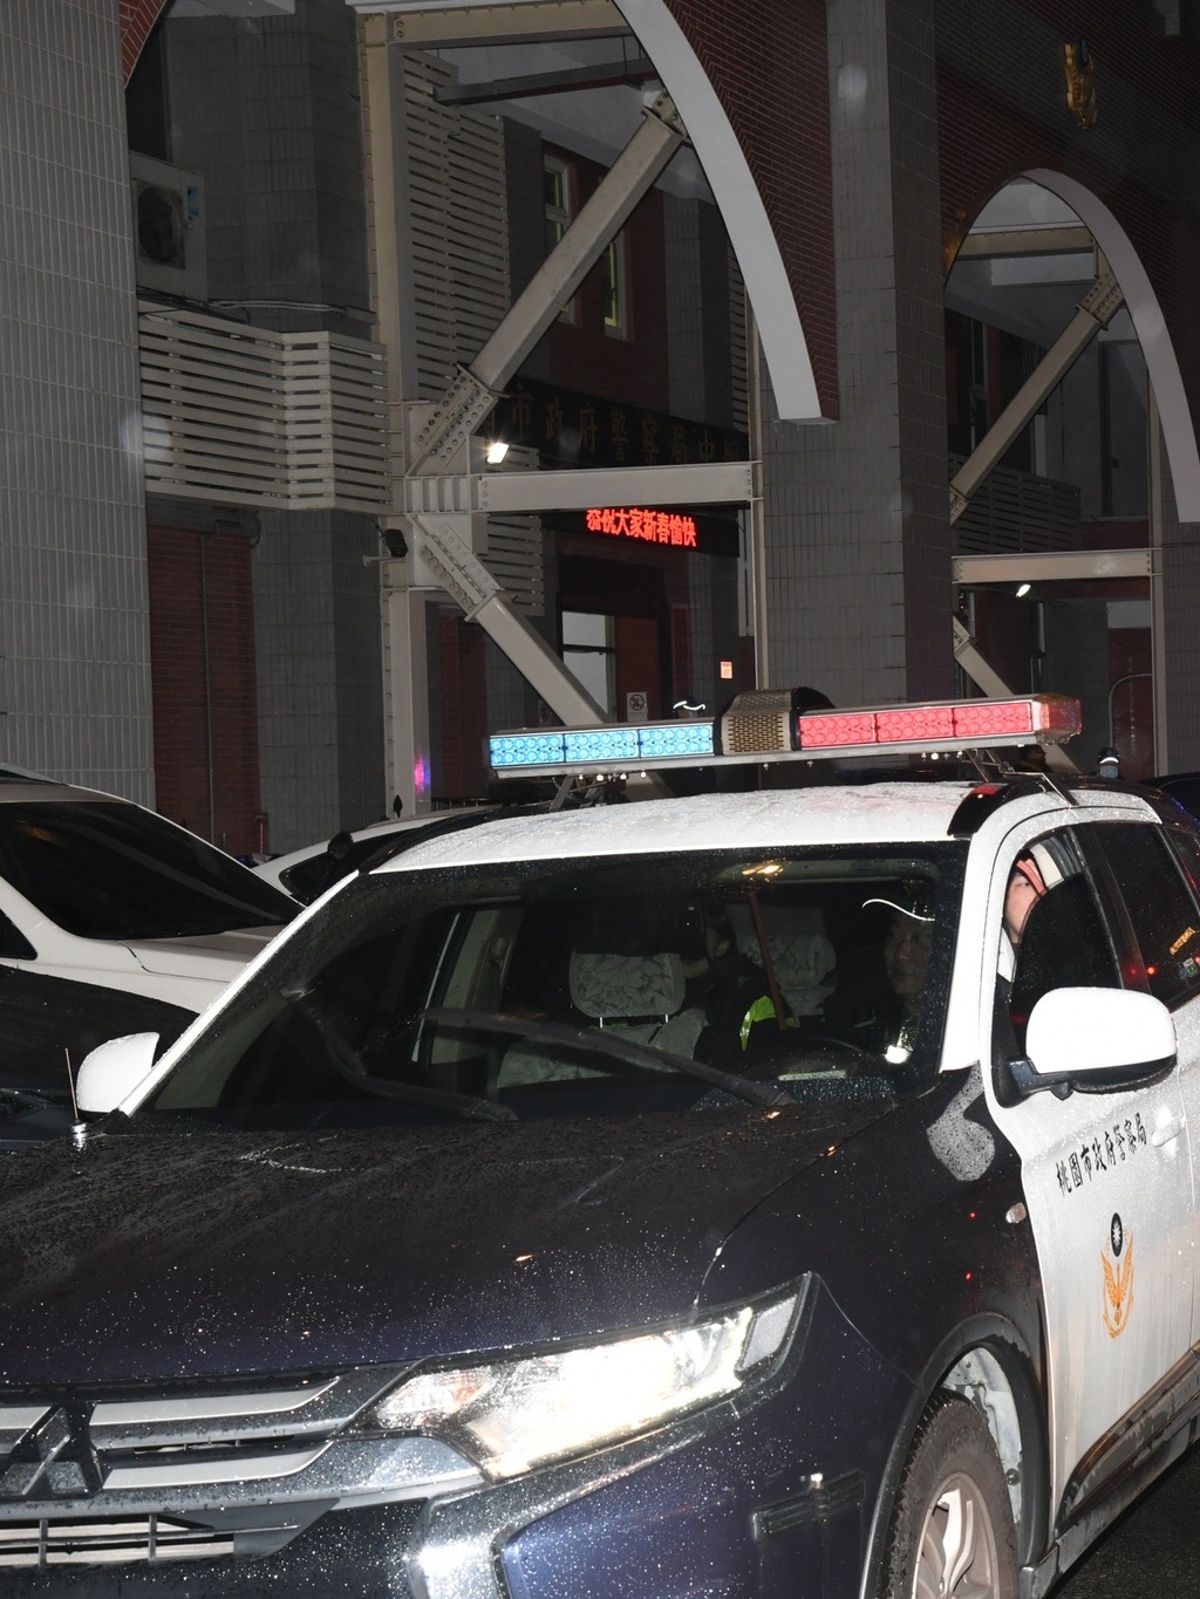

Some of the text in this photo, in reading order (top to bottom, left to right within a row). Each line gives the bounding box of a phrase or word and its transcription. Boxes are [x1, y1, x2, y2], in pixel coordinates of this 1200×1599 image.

[1056, 1112, 1147, 1198] 桃園市政府警察局
